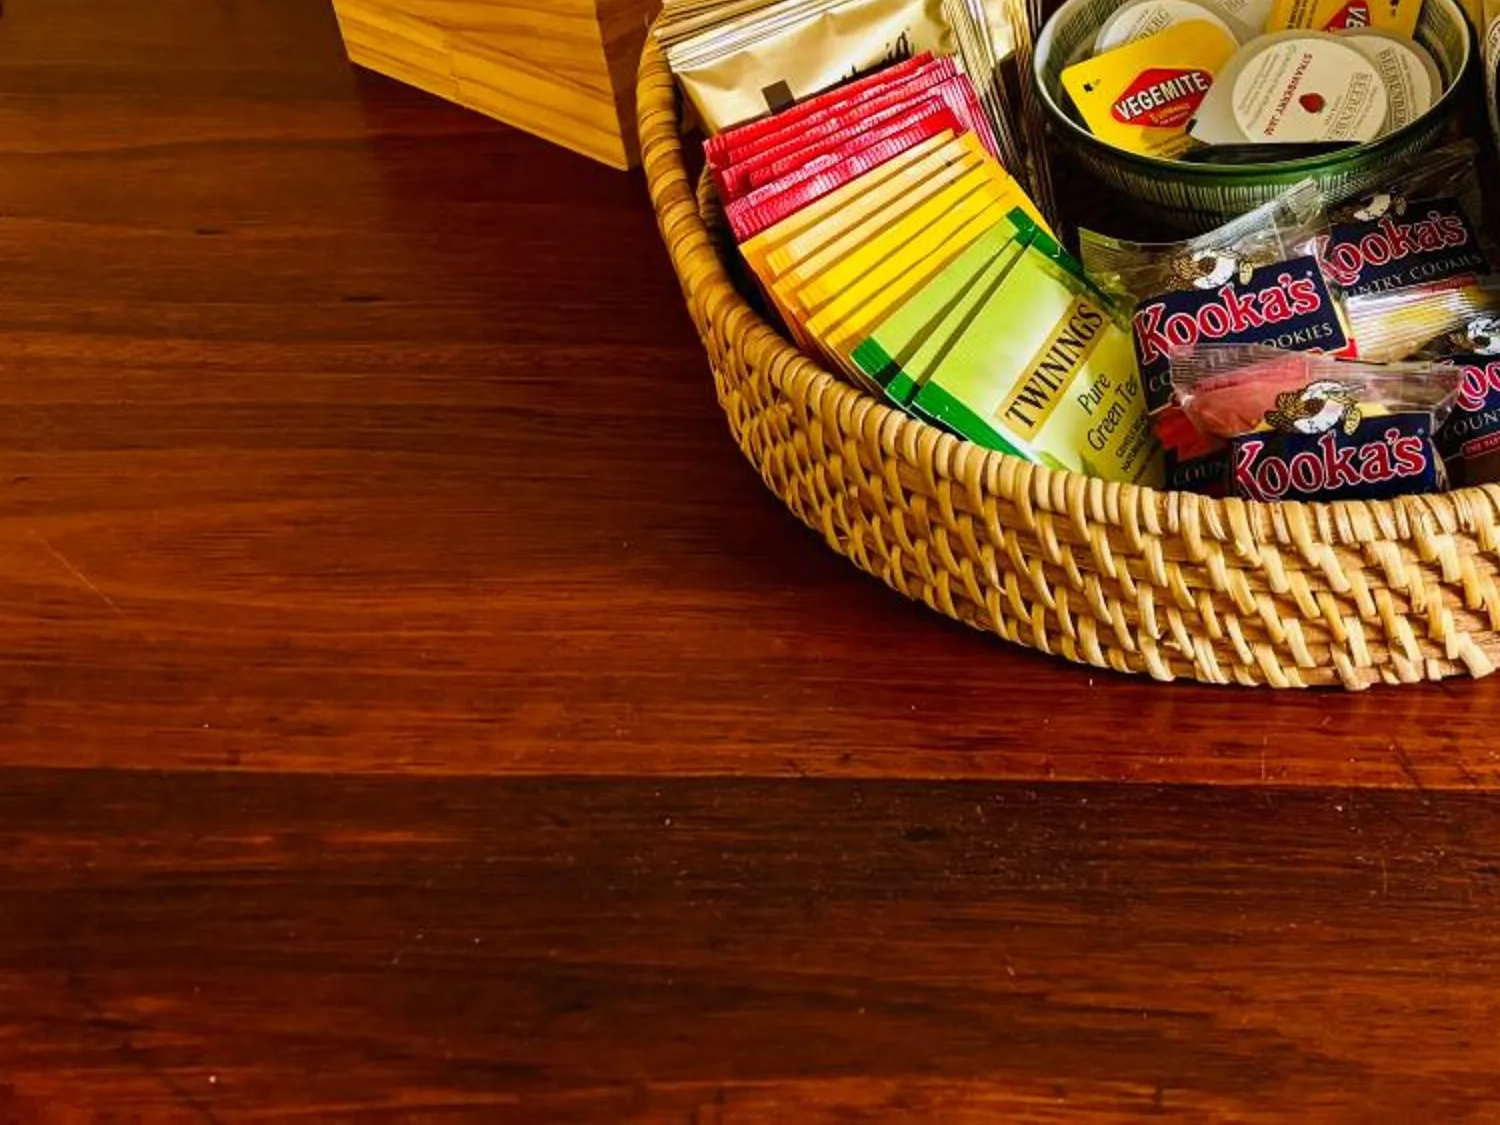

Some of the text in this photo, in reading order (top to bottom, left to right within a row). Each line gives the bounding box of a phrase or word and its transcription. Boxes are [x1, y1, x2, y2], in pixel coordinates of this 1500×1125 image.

[1115, 72, 1209, 120] VEGEMITE
[1132, 272, 1322, 366] Kooka's
[1005, 302, 1104, 430] TWININGS
[1077, 374, 1111, 416] Pure
[1087, 401, 1126, 452] Green
